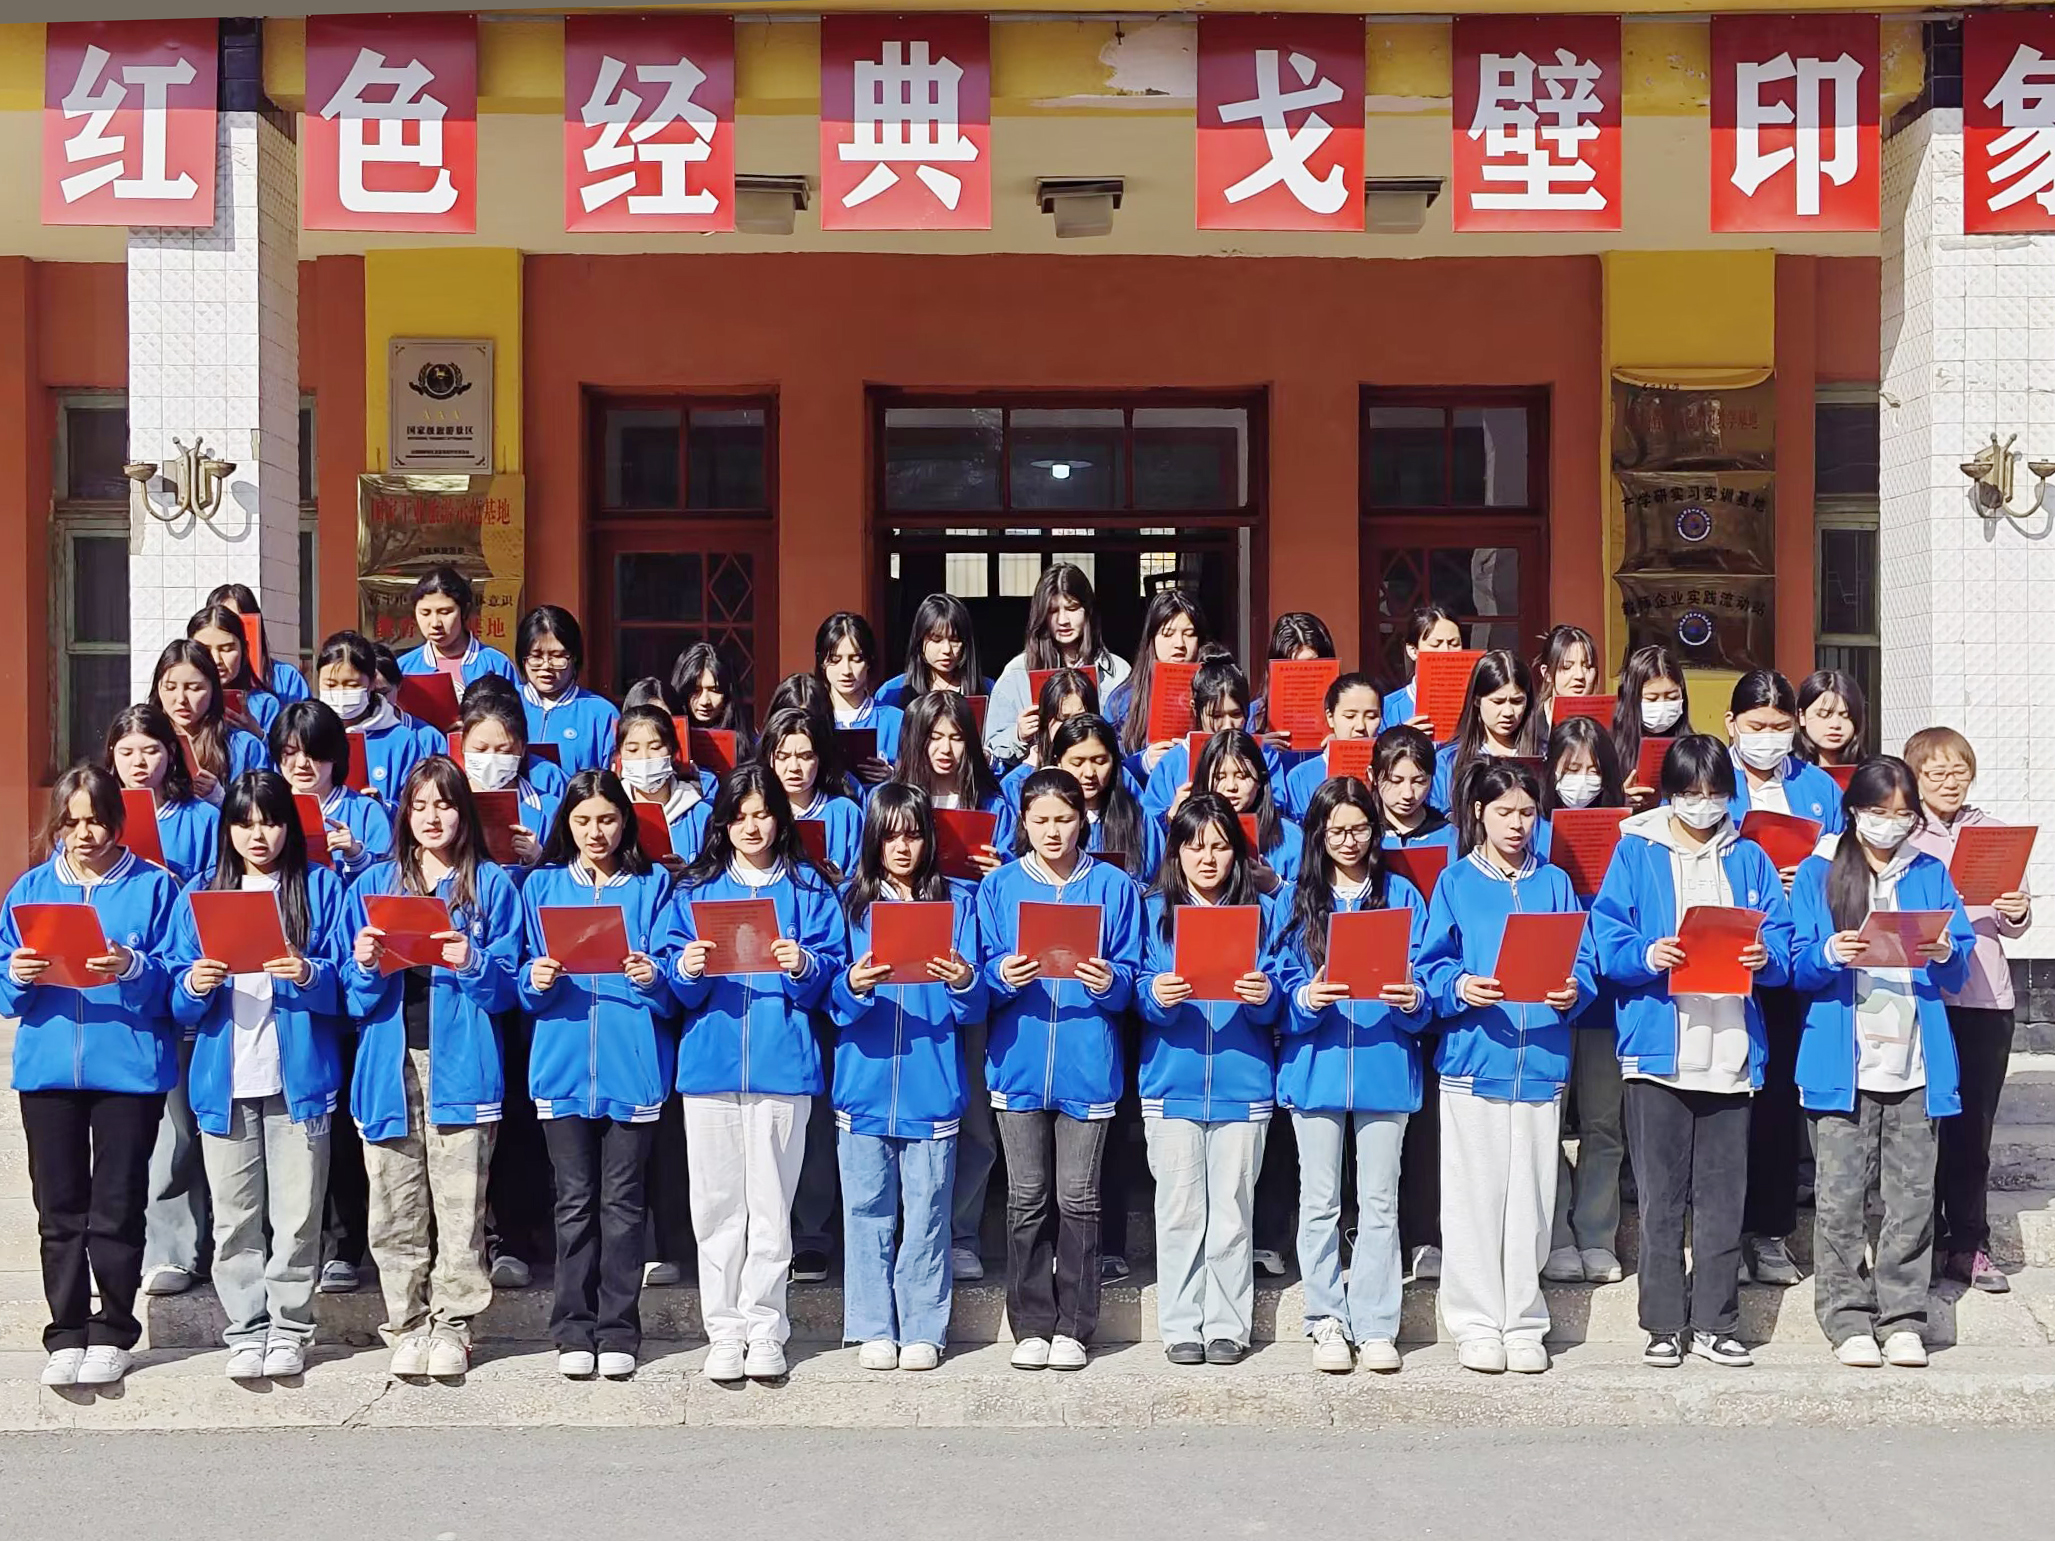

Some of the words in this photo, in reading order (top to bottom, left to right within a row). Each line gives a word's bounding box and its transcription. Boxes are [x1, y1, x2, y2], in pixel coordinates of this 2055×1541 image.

[60, 44, 199, 205] 红
[320, 46, 460, 214] 色
[579, 54, 720, 214] 经
[837, 40, 980, 211] 典
[1217, 48, 1350, 215] 戈
[1467, 47, 1608, 211] 壁
[1730, 51, 1865, 216] 印
